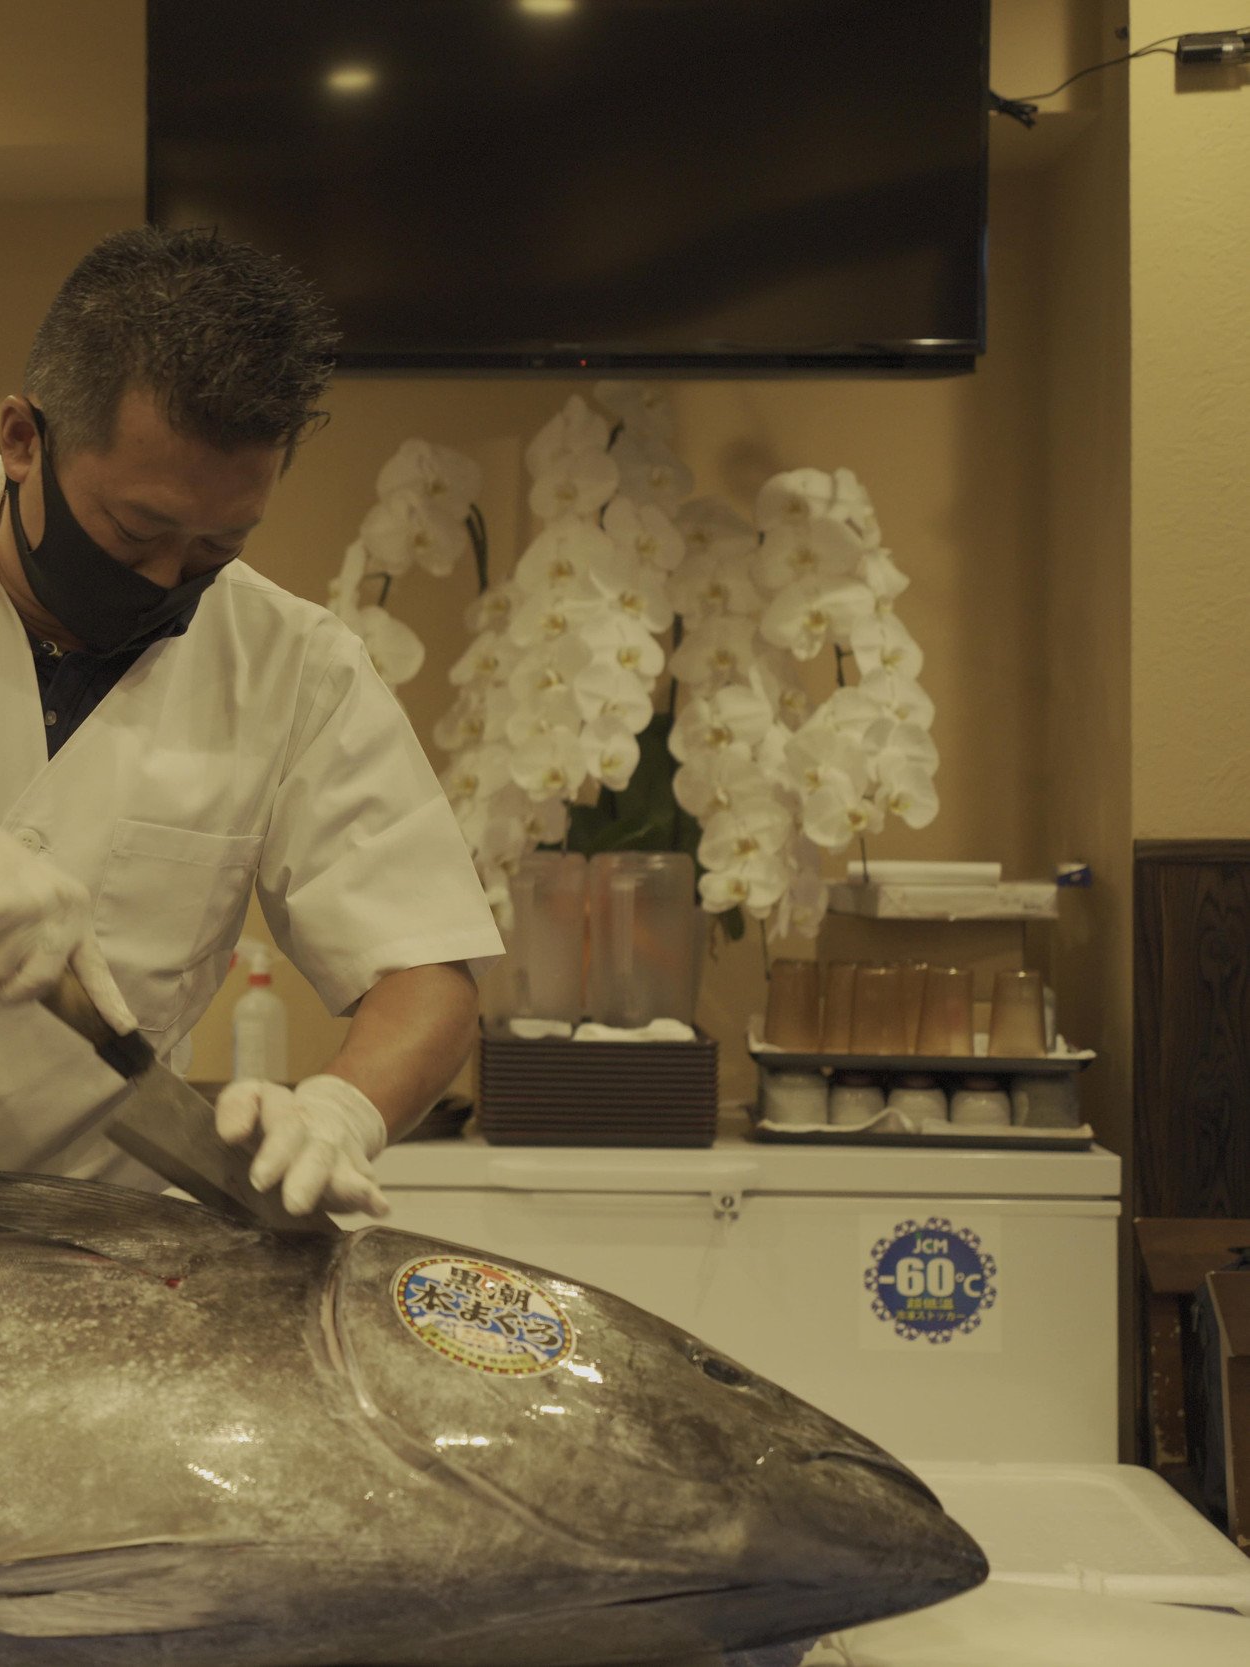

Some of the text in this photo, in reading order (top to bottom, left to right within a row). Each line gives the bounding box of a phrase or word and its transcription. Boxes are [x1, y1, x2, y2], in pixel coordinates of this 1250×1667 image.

[913, 1236, 949, 1254] JCM
[444, 1266, 532, 1313] 黒潮
[411, 1283, 558, 1346] 本まぐろ
